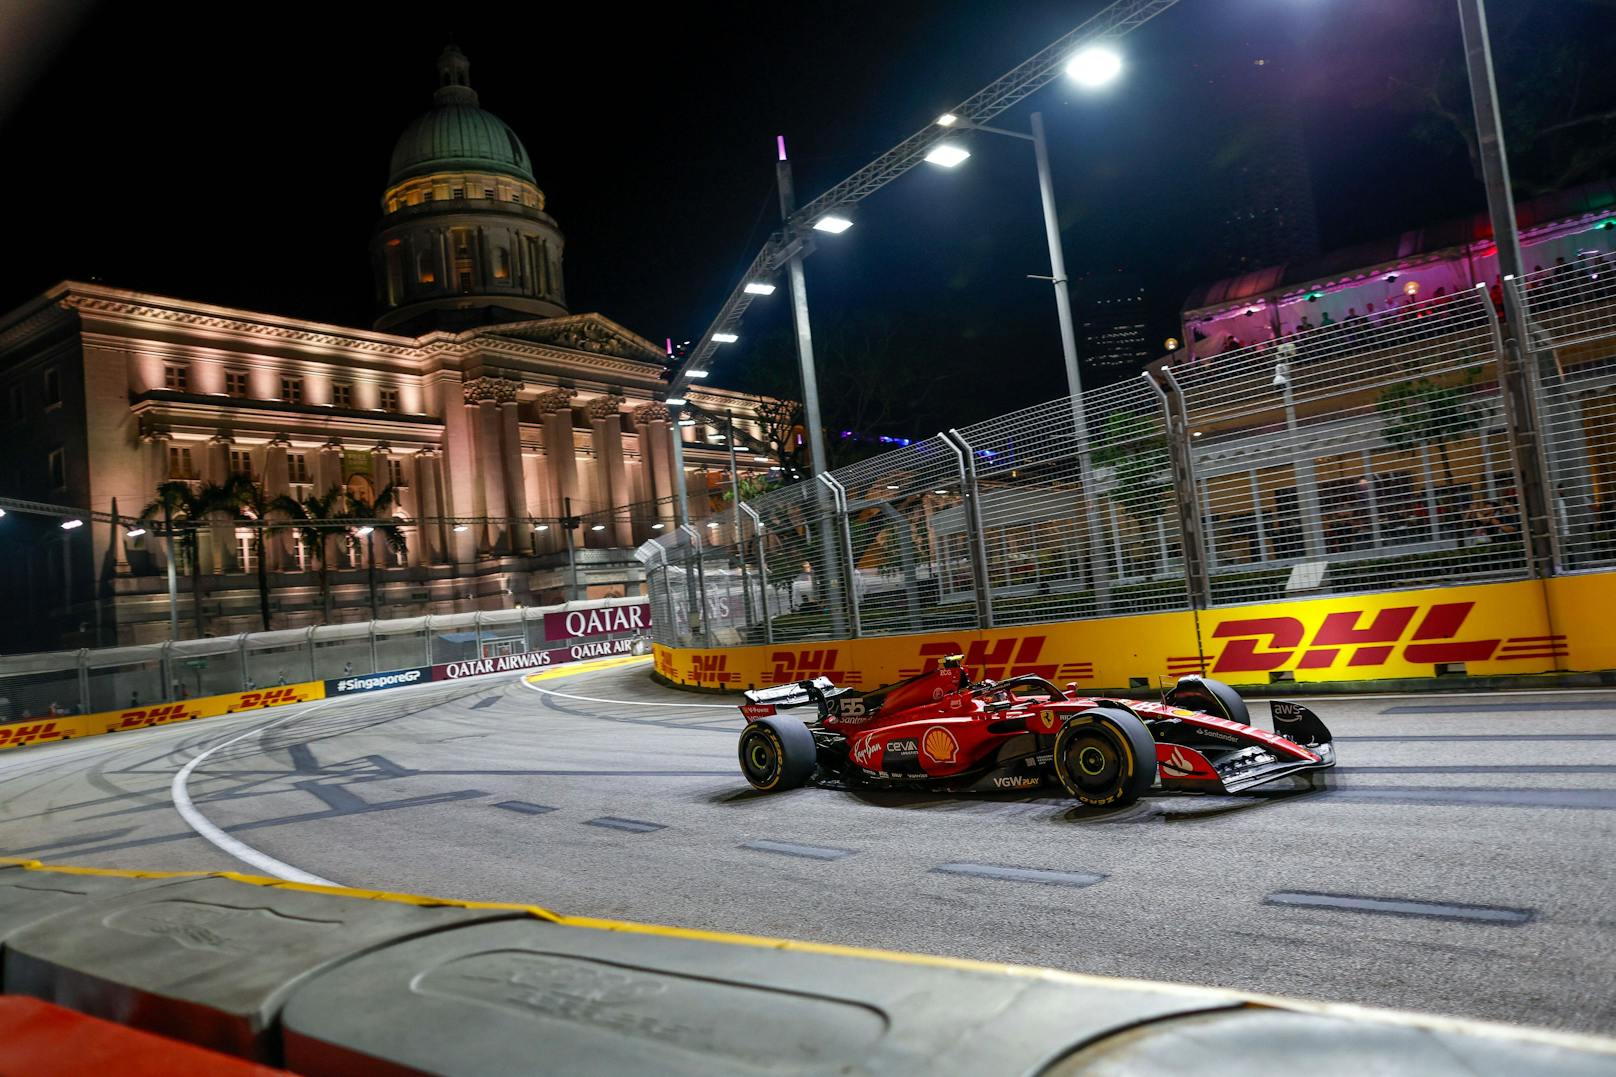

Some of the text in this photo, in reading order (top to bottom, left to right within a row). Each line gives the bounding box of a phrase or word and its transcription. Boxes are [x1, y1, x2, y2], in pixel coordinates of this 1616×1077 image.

[566, 606, 644, 637] QATAR
[1212, 601, 1501, 673] DHL
[571, 641, 611, 659] QATAR
[919, 636, 1059, 681] DHL
[446, 652, 551, 678] QATAR AIRWAYS
[692, 655, 731, 682] DHL
[772, 649, 845, 683] DHL
[338, 671, 421, 692] #SingaporeGP
[240, 688, 297, 709] DHL
[840, 698, 865, 716] 55
[1274, 704, 1300, 714] aws
[120, 704, 188, 728] DHL
[1204, 729, 1239, 743] Santander
[993, 776, 1022, 788] VGW
